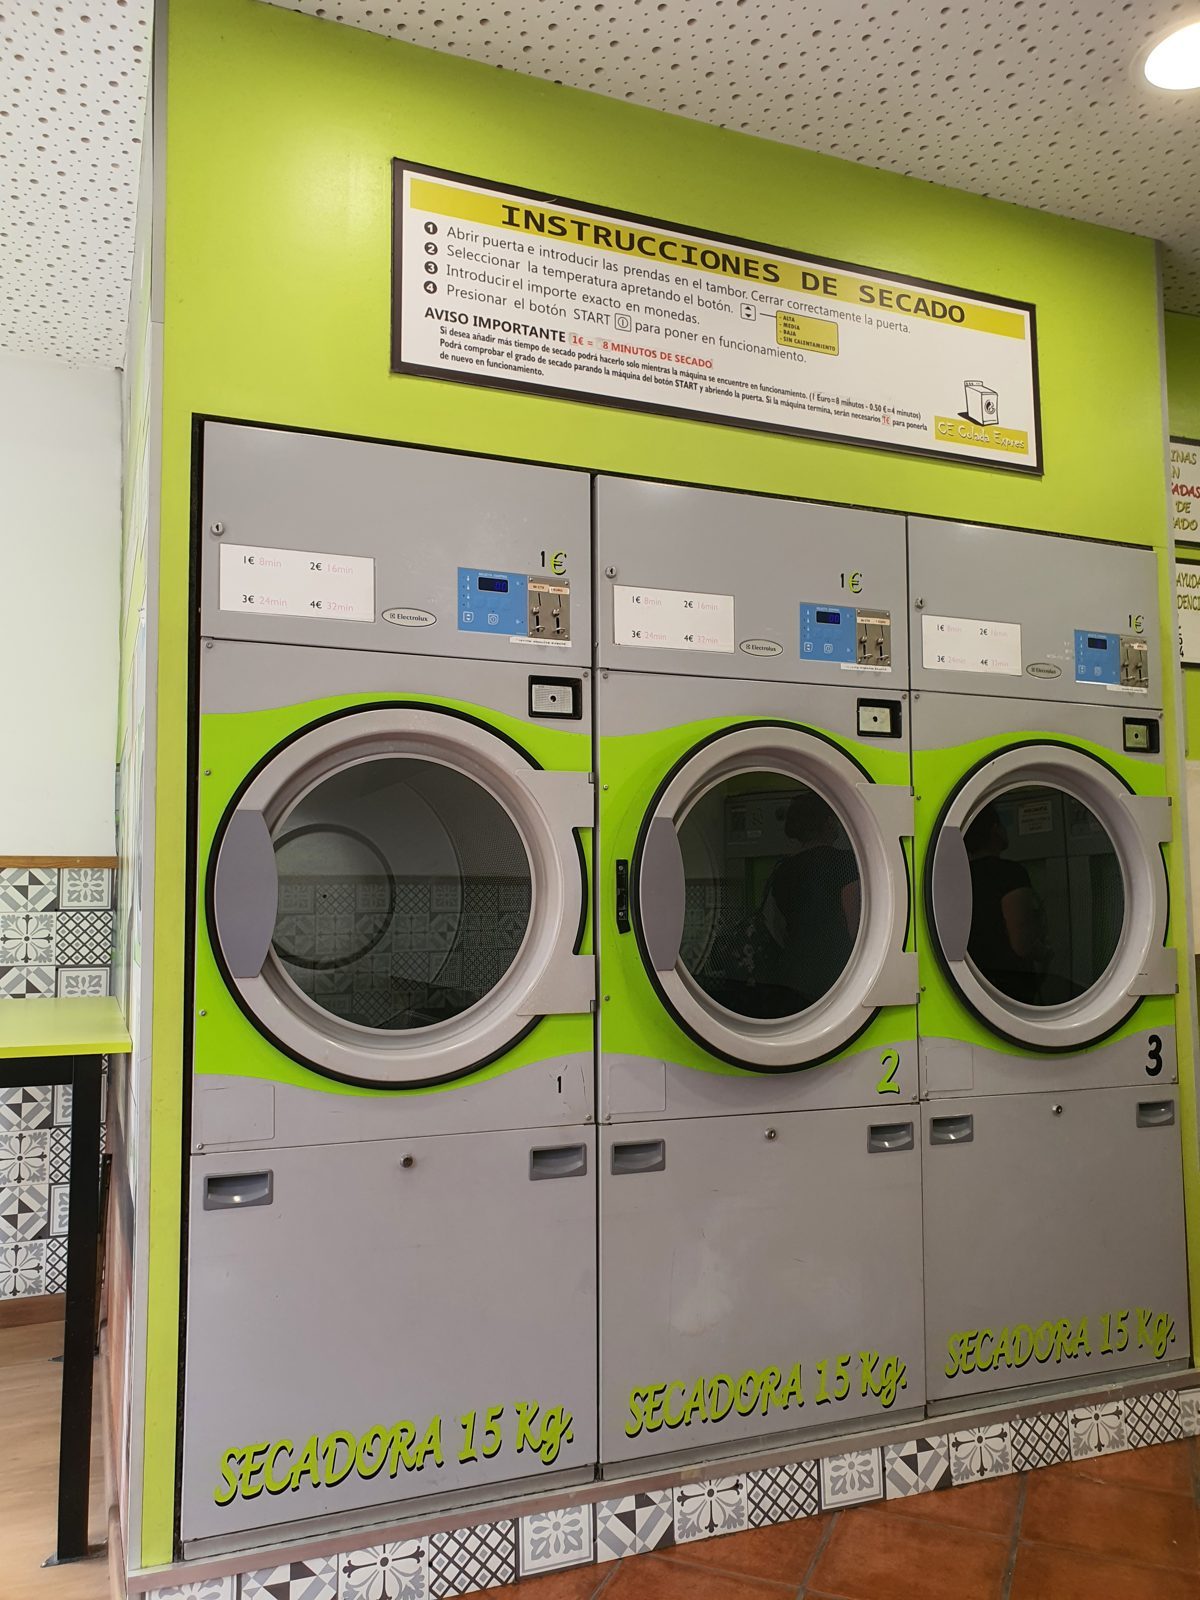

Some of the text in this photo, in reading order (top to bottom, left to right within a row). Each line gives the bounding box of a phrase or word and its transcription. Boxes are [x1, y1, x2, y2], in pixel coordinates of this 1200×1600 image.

[501, 204, 966, 324] INSTRUCCIONES DE SECADO
[446, 225, 480, 243] Abrir
[482, 234, 525, 256] puerta
[527, 245, 535, 255] e
[539, 244, 599, 268] introducir
[602, 258, 619, 272] las
[623, 262, 671, 286] prendas
[674, 276, 689, 287] en
[692, 276, 702, 289] el
[705, 280, 748, 299] tambor.
[750, 289, 785, 306] Cerrar
[786, 299, 862, 323] correctamente
[864, 313, 873, 325] la
[876, 318, 911, 335] puerta.
[447, 243, 521, 270] Seleccionar
[528, 260, 538, 273] la
[542, 265, 618, 292] temperatura
[620, 280, 681, 305] apretando
[683, 292, 694, 305] el
[697, 295, 734, 313] botón.
[447, 264, 509, 287] Introducir
[513, 276, 523, 290] el
[528, 281, 577, 303] importe
[582, 292, 621, 309] exacto
[626, 302, 640, 313] en
[645, 303, 700, 324] monedas.
[447, 284, 507, 306] Presionar
[514, 296, 524, 309] el
[530, 299, 566, 317] botón
[573, 308, 611, 325] START
[635, 321, 661, 337] para
[664, 327, 699, 344] poner
[701, 334, 716, 345] en
[719, 335, 807, 363] funcionamiento.
[783, 322, 800, 330] MEDIA
[424, 306, 468, 325] AVISO
[473, 315, 566, 342] IMPORTANTE
[602, 340, 609, 349] 8
[611, 342, 657, 358] MINUTOS
[660, 351, 672, 361] DE
[675, 354, 713, 368] SECADO
[794, 338, 836, 351] CALENTAMIENTO
[439, 350, 544, 376] de nuevo en funcionamiento.
[439, 325, 448, 335] Si
[448, 327, 471, 339] desea
[472, 331, 497, 343] añadir
[497, 336, 513, 346] más
[513, 339, 540, 353] tiempo
[541, 343, 551, 353] de
[551, 345, 577, 357] secado
[577, 350, 599, 363] podrá
[599, 353, 625, 366] hacerlo
[626, 358, 640, 368] solo
[641, 361, 671, 374] mientras
[671, 367, 678, 375] la
[679, 368, 708, 382] máquina
[716, 377, 749, 388] encuentre
[759, 383, 808, 399] funcionamiento.
[868, 402, 882, 412] 0.50
[896, 408, 922, 420] minutos)
[439, 338, 463, 350] Podrá
[463, 342, 505, 359] comprobar
[506, 349, 513, 358] el
[514, 351, 536, 364] grado
[537, 355, 547, 364] de
[548, 357, 573, 369] secado
[573, 361, 603, 376] parando
[603, 366, 611, 375] la
[611, 368, 641, 382] máquina
[641, 373, 653, 382] del
[653, 375, 674, 386] botón
[674, 379, 699, 390] START
[704, 384, 734, 397] abriendo
[734, 390, 741, 398] la
[741, 392, 765, 404] puerta.
[765, 395, 772, 403] Si
[773, 396, 779, 405] la
[780, 398, 806, 411] máquina
[807, 403, 833, 414] termina,
[833, 408, 850, 418] serán
[851, 412, 881, 422] necesarios
[892, 419, 906, 428] para
[906, 420, 928, 432] ponerla
[937, 420, 1025, 450] CE Colada Expres
[243, 556, 282, 568] 1€ 8min
[310, 562, 353, 574] 2€ 16min
[242, 595, 287, 607] 3€ 24min
[310, 600, 354, 612] 4€ 32min
[632, 596, 641, 604] 1€
[684, 600, 693, 608] 2€
[397, 613, 428, 622] Electrolux
[937, 624, 944, 632] 1€
[632, 630, 641, 638] 3€
[684, 635, 694, 643] 4€
[980, 628, 988, 636] 2€
[751, 644, 776, 652] Electrolux
[1145, 1034, 1164, 1076] 3
[876, 1048, 900, 1094] 2
[557, 1076, 562, 1094] 1
[944, 1306, 1177, 1378] SECADORA 15 Kg.
[624, 1349, 907, 1438] SECADORA 15 Kg.
[213, 1400, 575, 1506] SECADORA 15 Kg.
